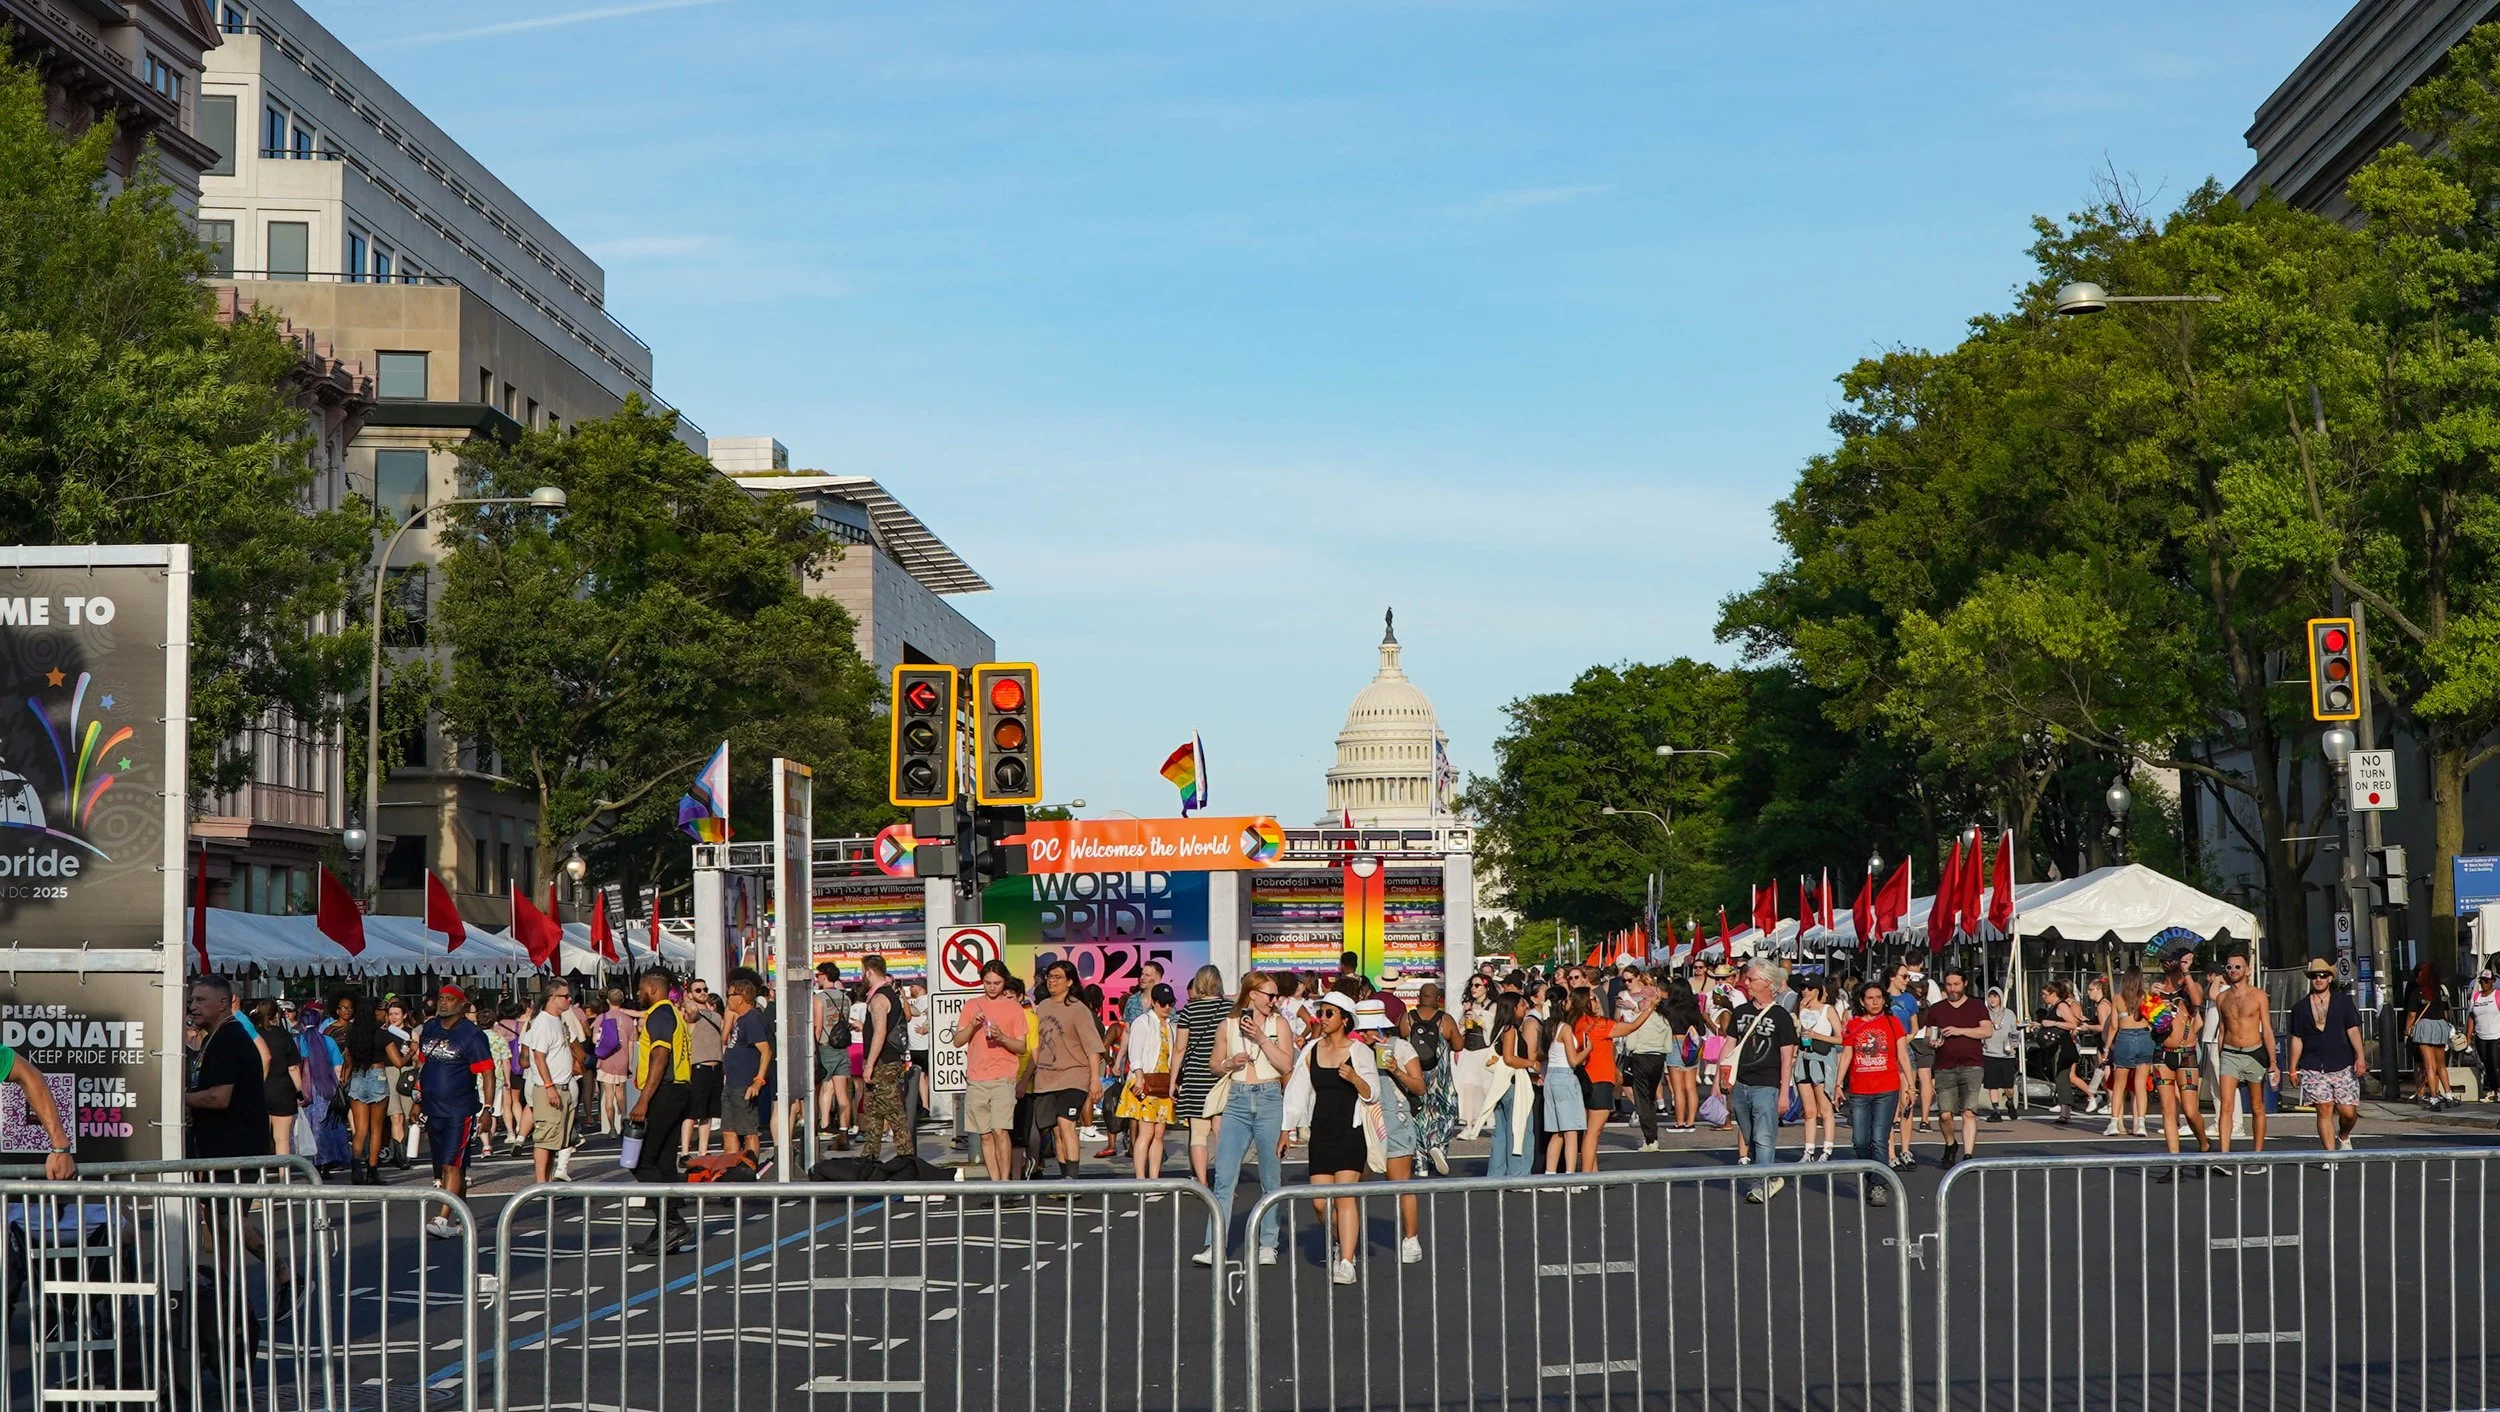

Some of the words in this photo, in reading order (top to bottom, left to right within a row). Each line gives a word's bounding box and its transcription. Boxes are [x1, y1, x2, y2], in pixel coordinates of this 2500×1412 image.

[64, 596, 116, 626] TO
[2361, 755, 2381, 767] NO
[2360, 769, 2386, 779] TURN
[2355, 781, 2368, 791] ON
[2373, 780, 2392, 790] RED
[1030, 838, 1062, 862] DC
[1070, 836, 1148, 860] Welcomes
[1150, 836, 1176, 857] the
[1179, 833, 1233, 857] World
[9, 886, 29, 899] DC
[32, 886, 69, 898] 2025
[1033, 871, 1172, 901] WORLD
[1035, 902, 1172, 942] PRIDE
[2, 1004, 87, 1020] PLEASE...
[936, 999, 966, 1014] THR
[2, 1020, 144, 1048] DONATE
[28, 1049, 63, 1064] KEEP
[67, 1049, 107, 1064] PRIDE
[111, 1049, 144, 1064] FREE
[77, 1077, 126, 1093] GIVE
[78, 1092, 137, 1108] PRIDE
[79, 1107, 122, 1123] 365
[79, 1122, 134, 1138] FUND
